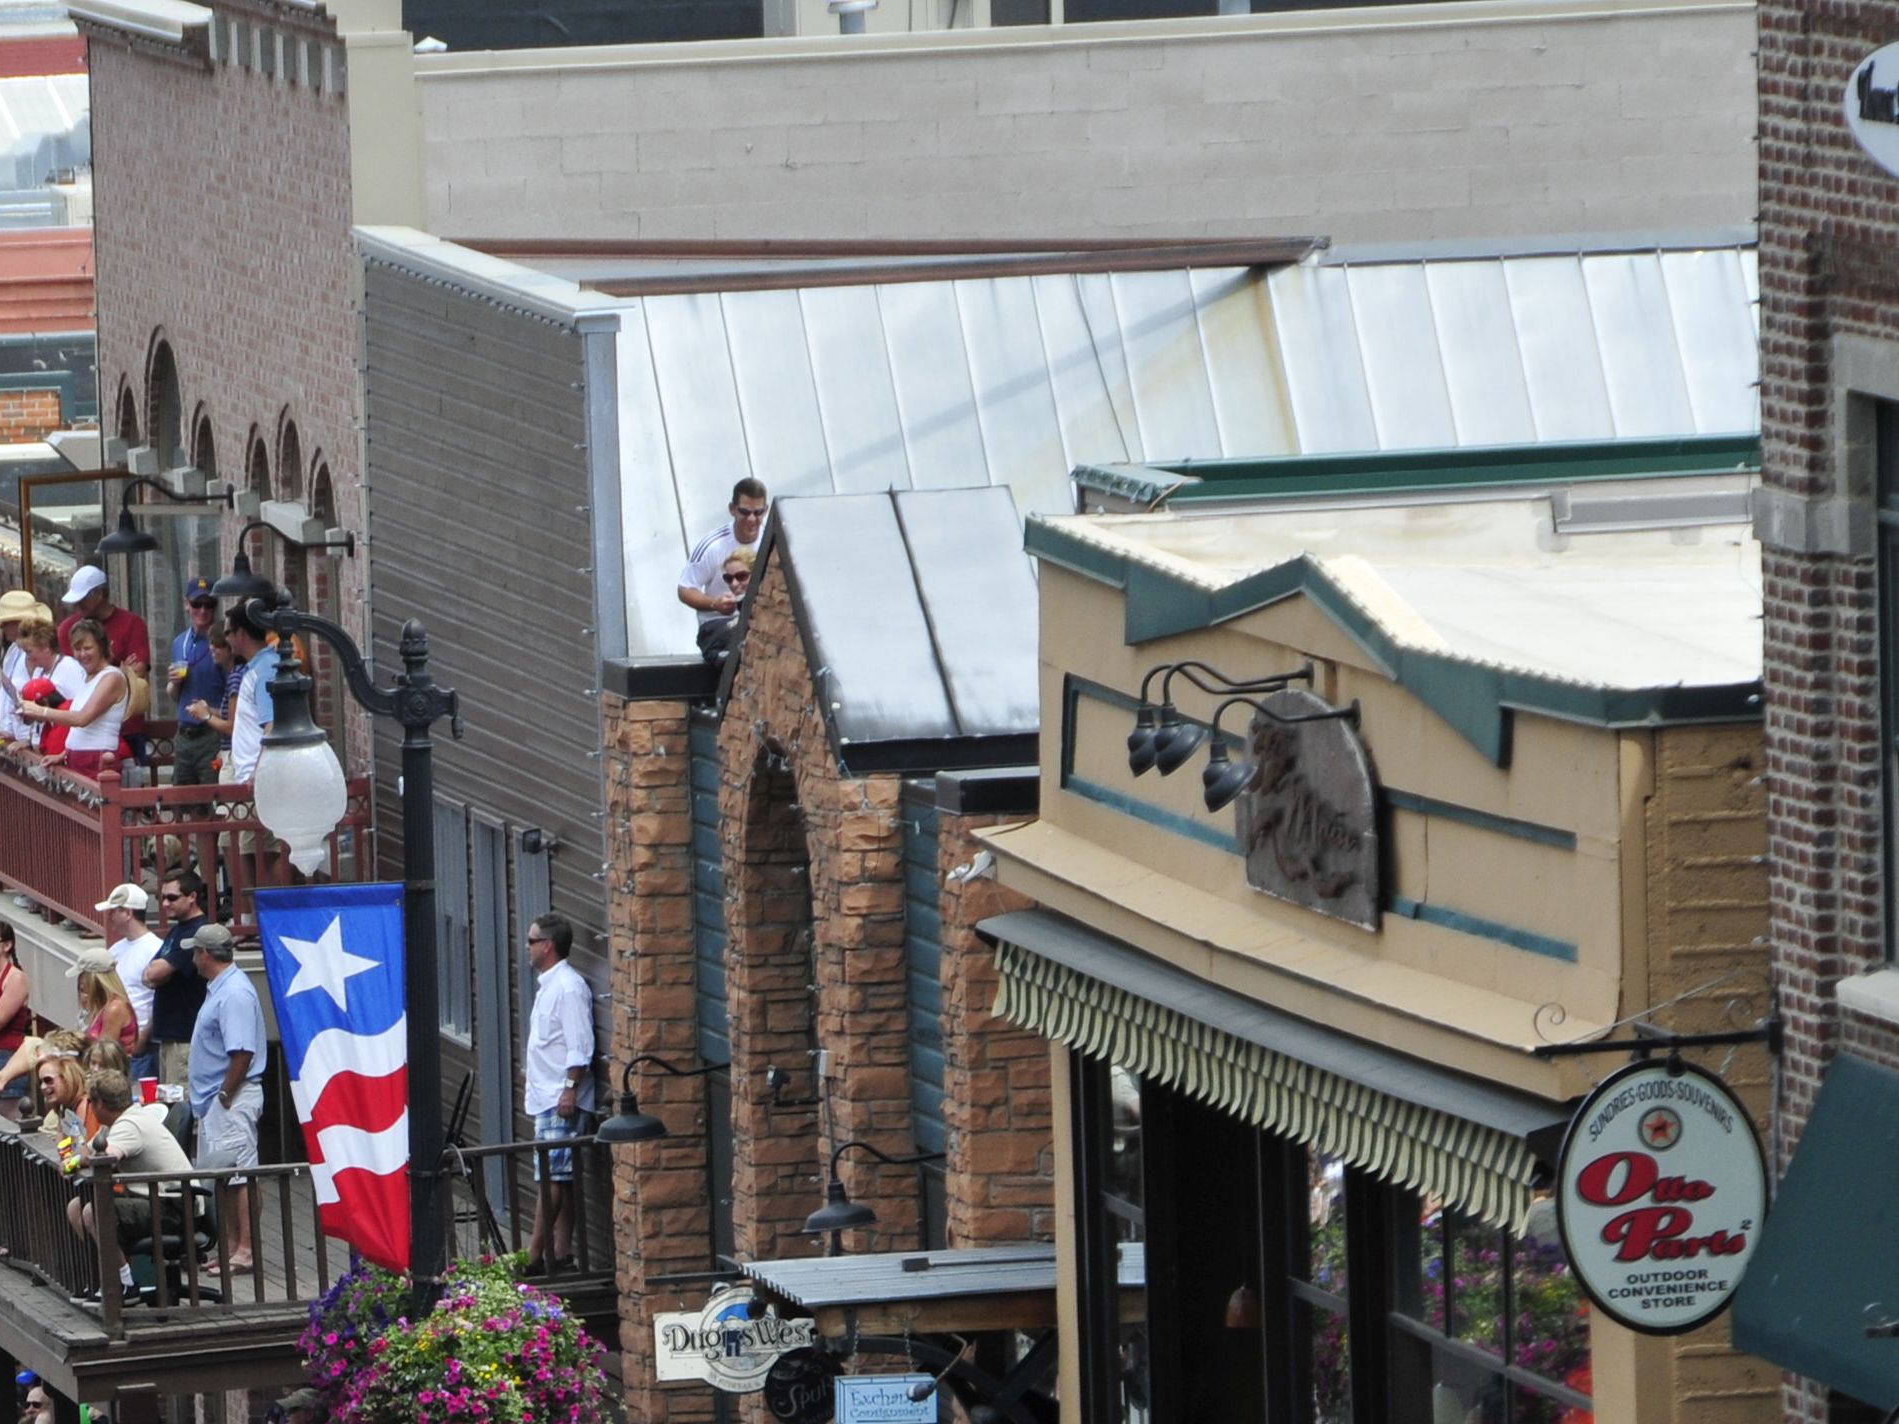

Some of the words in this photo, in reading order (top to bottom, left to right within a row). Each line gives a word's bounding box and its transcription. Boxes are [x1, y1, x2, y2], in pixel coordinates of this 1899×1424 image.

[1626, 1268, 1709, 1285] OUTDOOR
[1607, 1279, 1729, 1300] CONVENIENCE
[1640, 1295, 1697, 1310] STORE
[849, 1406, 929, 1420] Consignment
